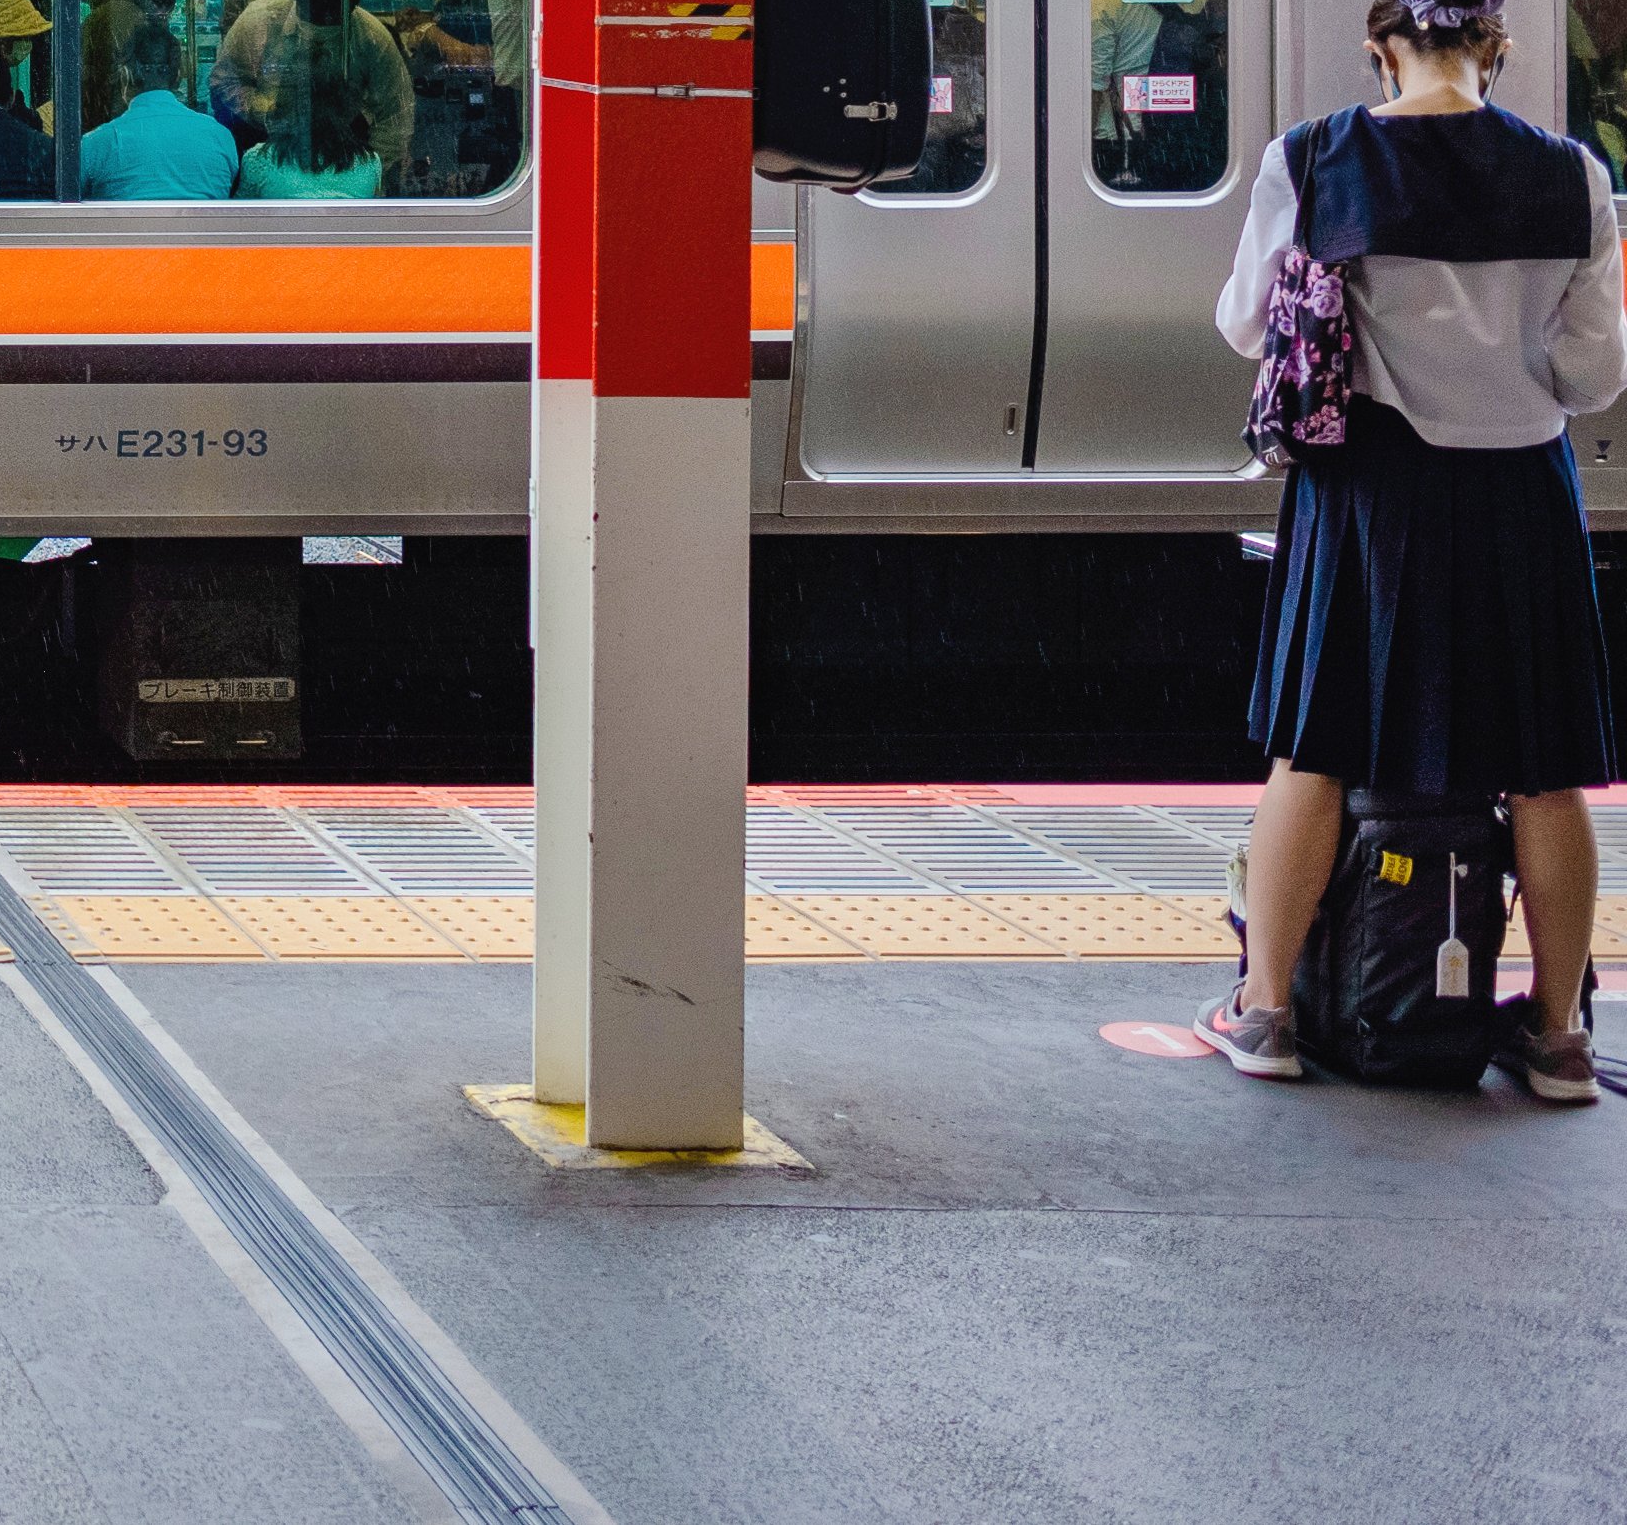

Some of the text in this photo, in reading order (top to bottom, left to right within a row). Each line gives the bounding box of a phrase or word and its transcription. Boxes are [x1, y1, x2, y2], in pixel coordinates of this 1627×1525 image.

[55, 428, 269, 458] サハ E231-93
[1131, 1026, 1186, 1051] 1
